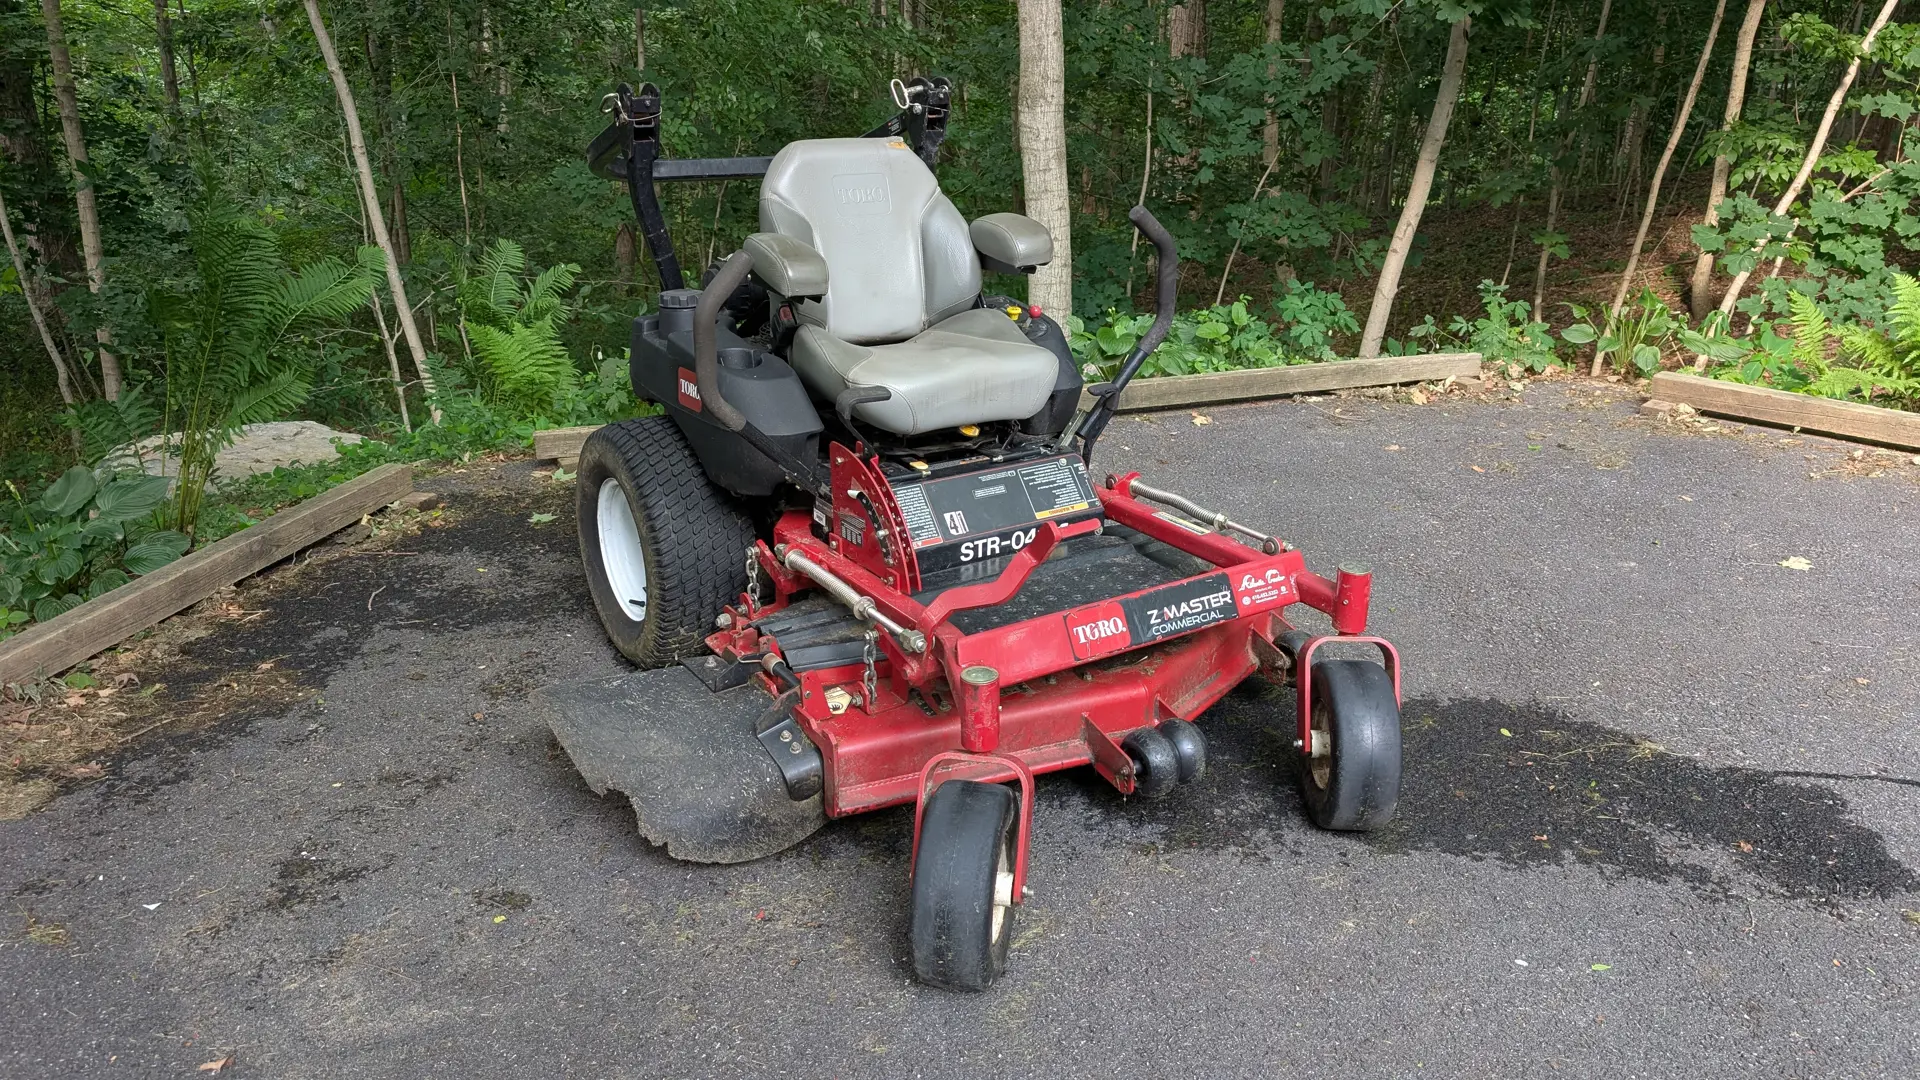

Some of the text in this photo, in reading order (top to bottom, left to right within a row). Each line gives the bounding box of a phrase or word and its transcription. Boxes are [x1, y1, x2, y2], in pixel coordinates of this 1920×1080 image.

[1147, 590, 1233, 625] Z MASTER
[1152, 609, 1225, 636] COMMERCIAL
